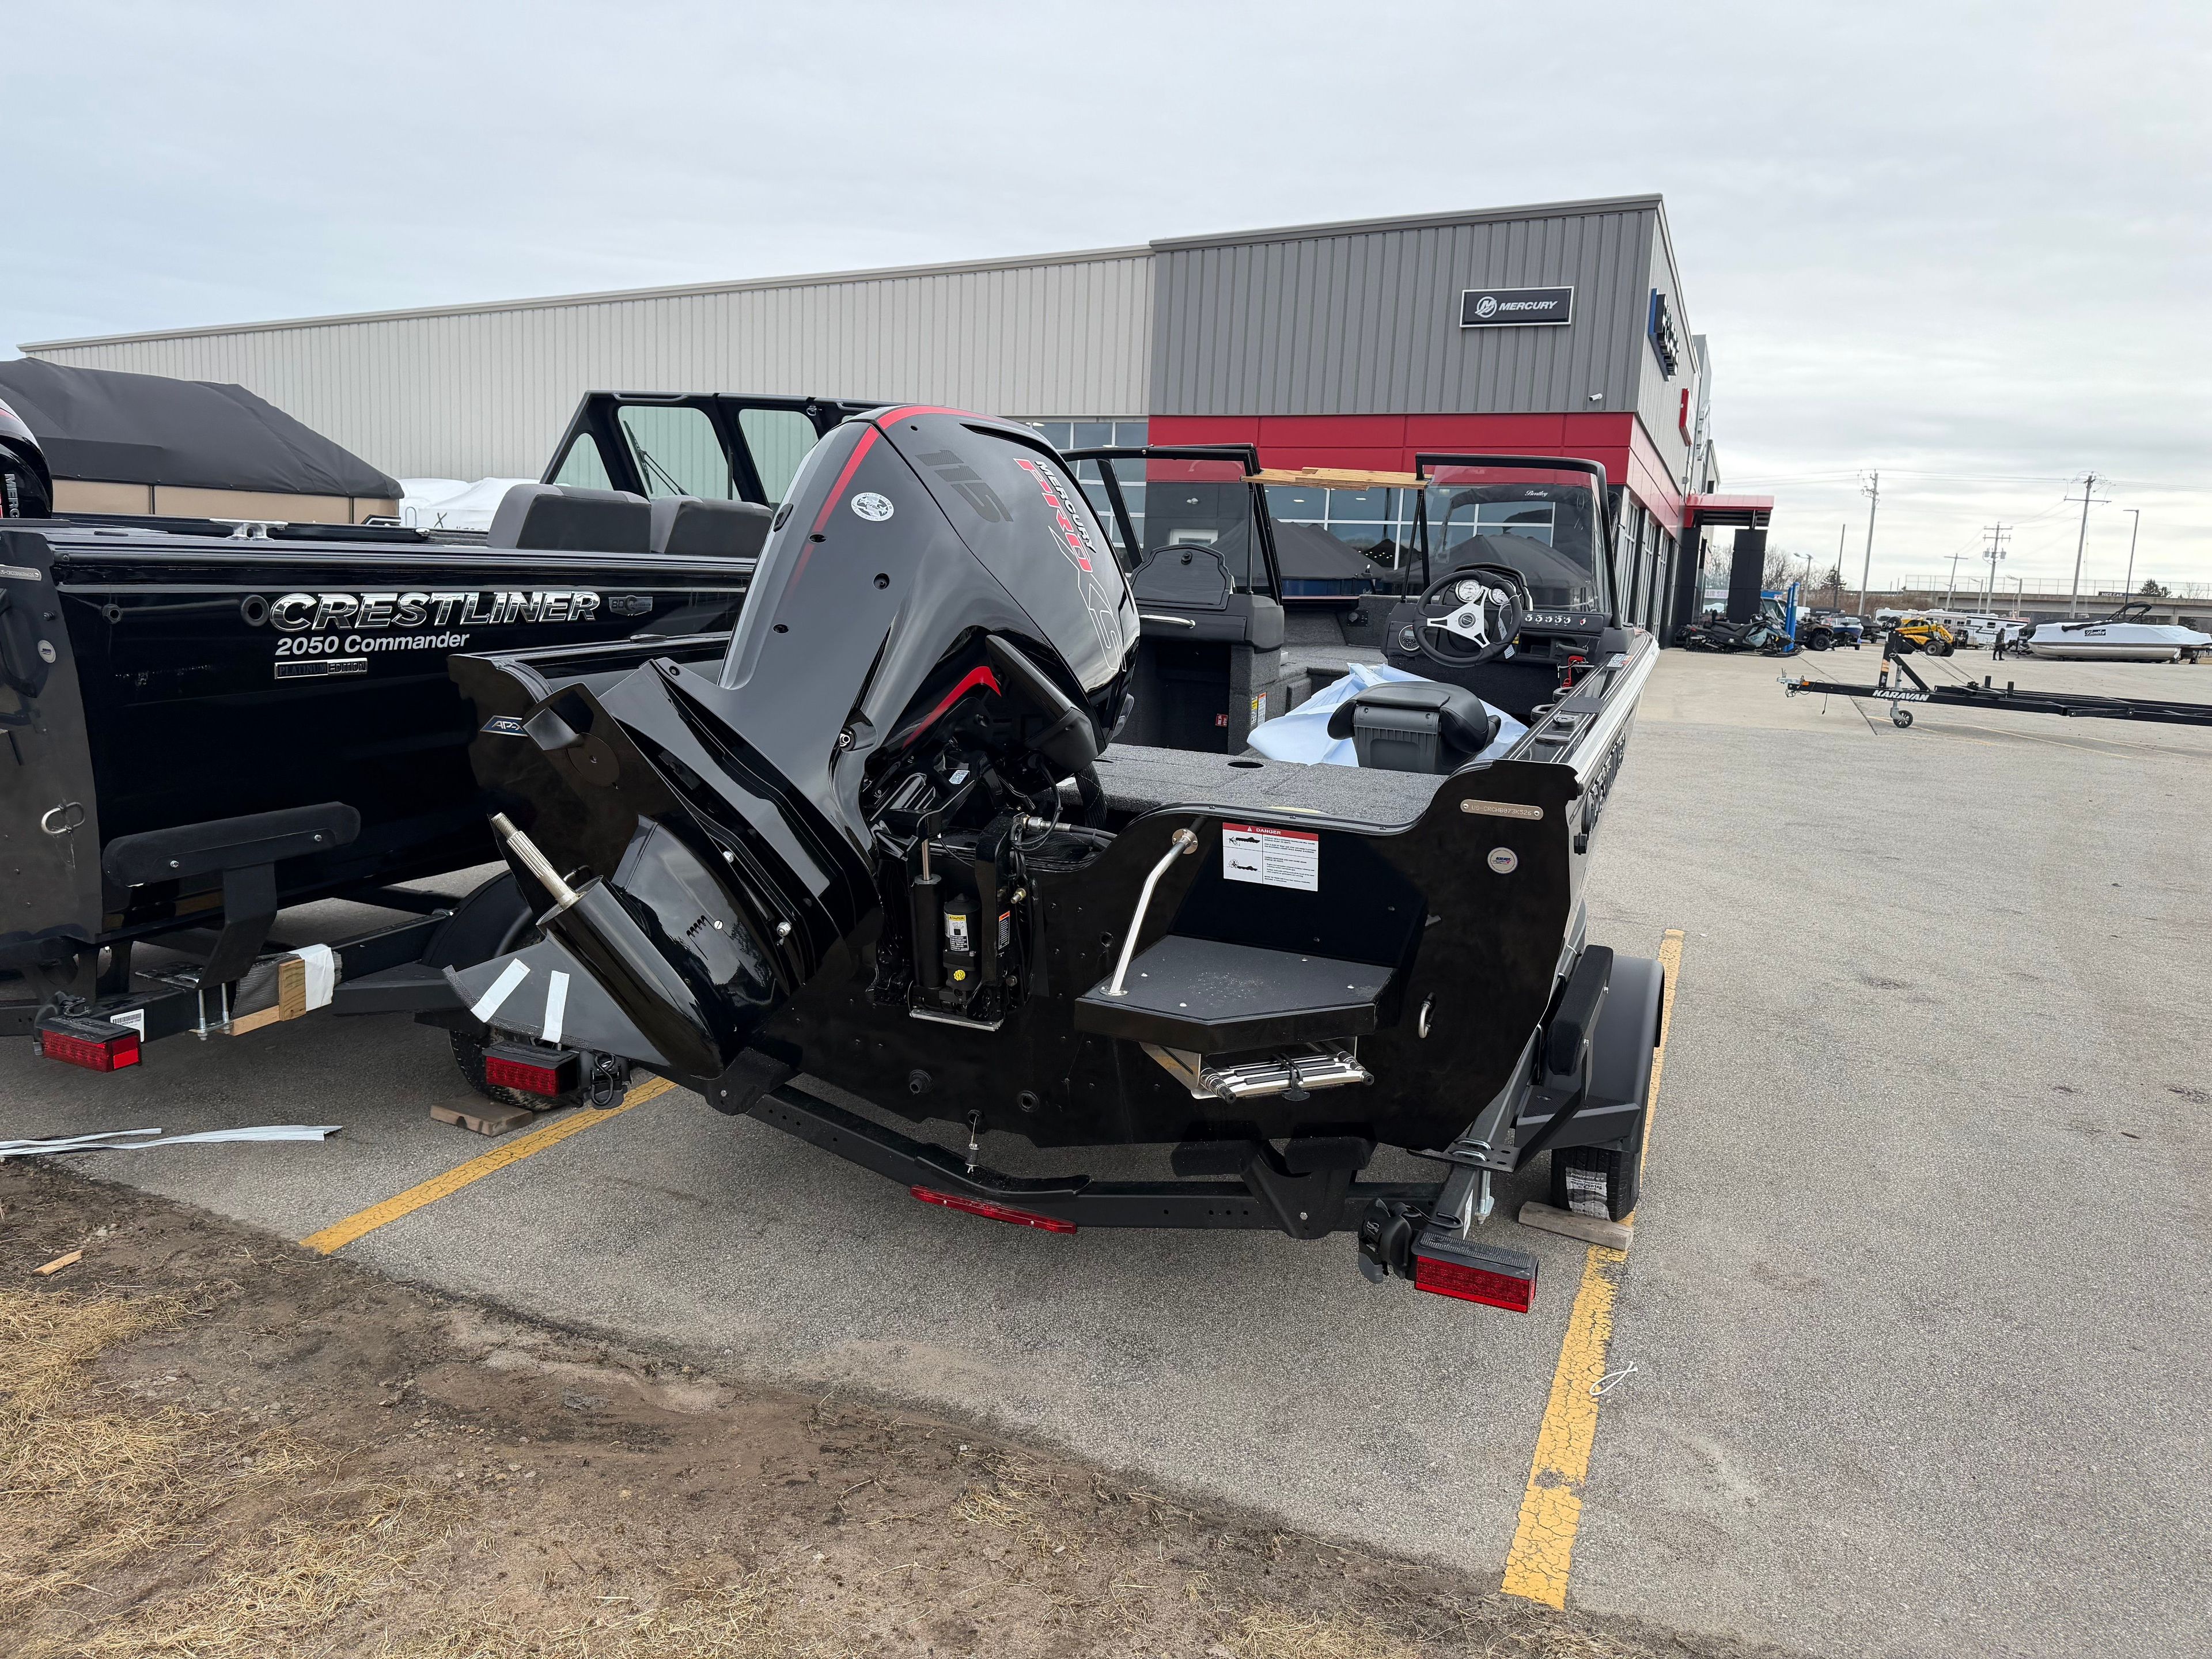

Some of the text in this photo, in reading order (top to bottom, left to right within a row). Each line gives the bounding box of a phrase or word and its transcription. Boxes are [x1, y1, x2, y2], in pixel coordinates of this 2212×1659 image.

[1499, 301, 1558, 311] MERCURY
[915, 449, 1014, 523] 115
[1013, 457, 1093, 573] PRO
[1034, 460, 1097, 554] MERCURY
[269, 591, 601, 632] CRESTLINER
[275, 631, 470, 656] 2050 Commander
[278, 661, 366, 676] PLATINUM EDITION
[1872, 690, 1930, 702] KARAVAN
[1256, 827, 1282, 835] DANGER
